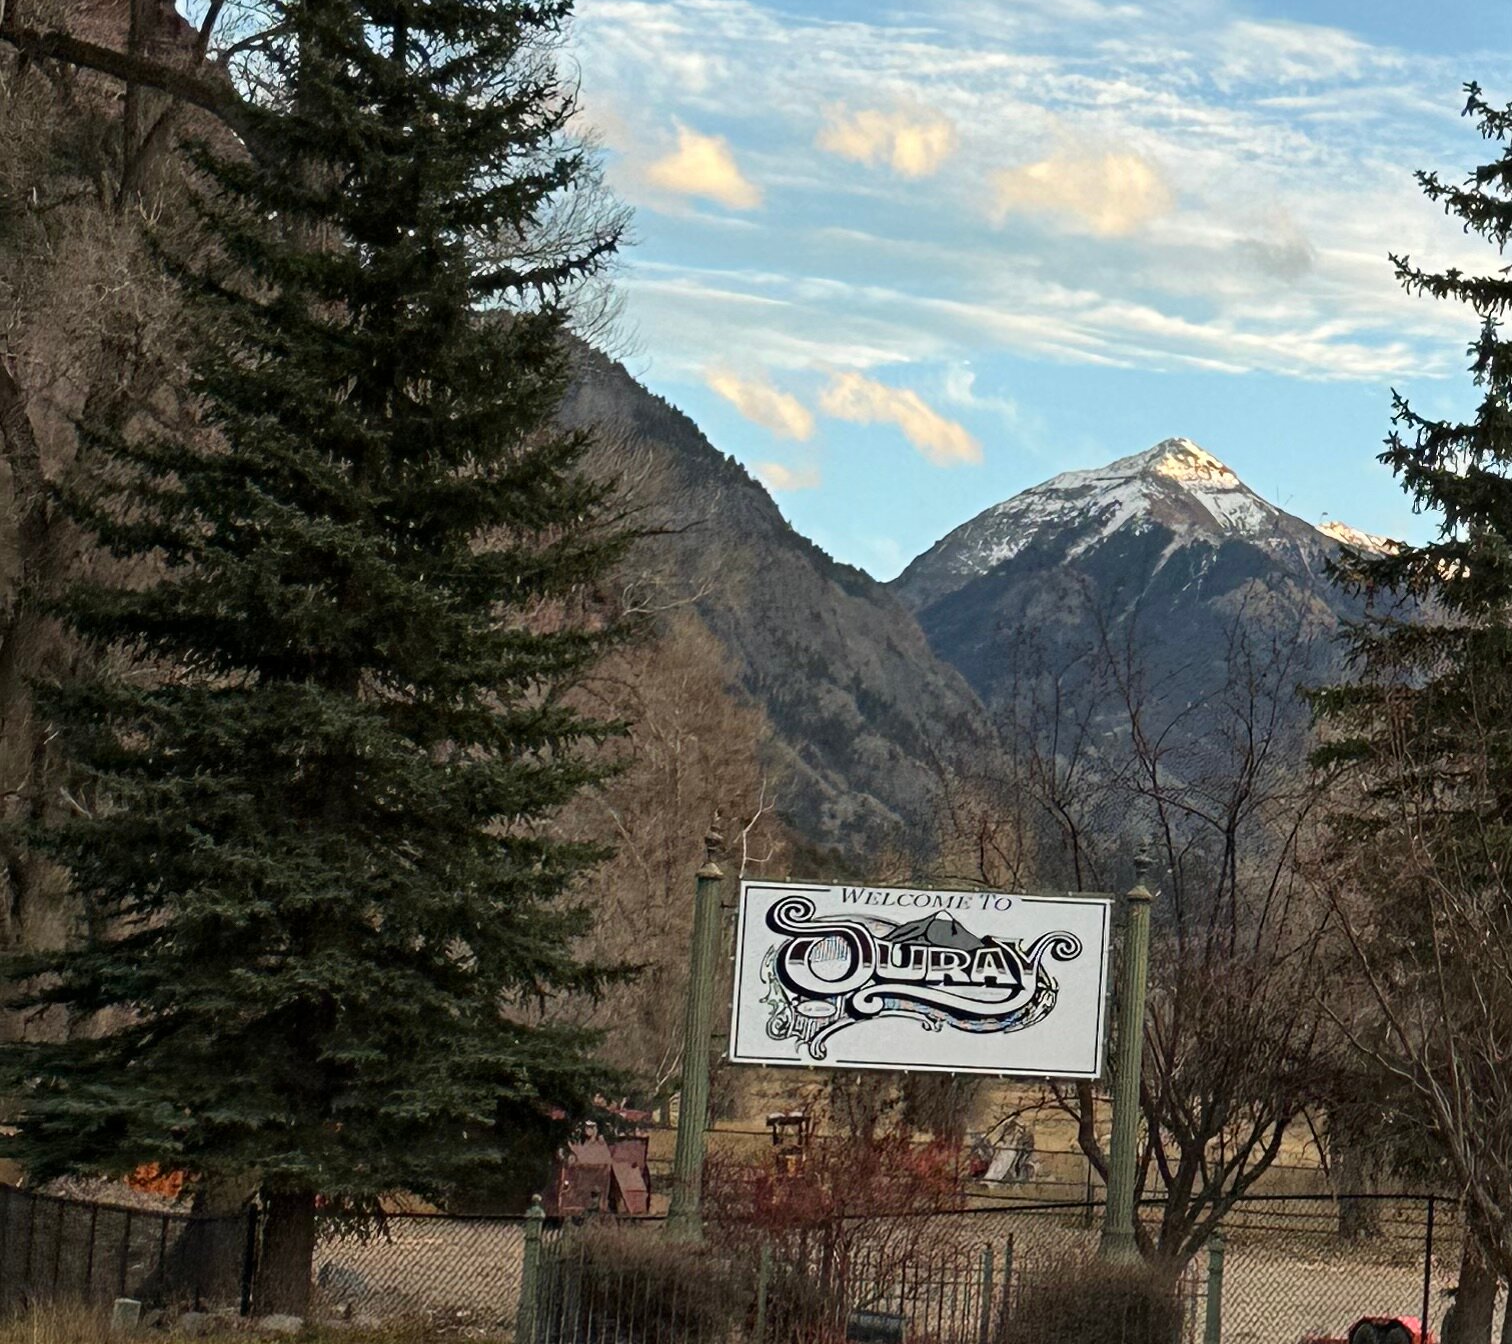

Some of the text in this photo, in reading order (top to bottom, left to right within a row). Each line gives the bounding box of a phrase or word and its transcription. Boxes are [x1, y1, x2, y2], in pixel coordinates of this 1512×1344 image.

[841, 887, 1013, 912] WELCOME TO
[766, 895, 1083, 1018] OURAY
